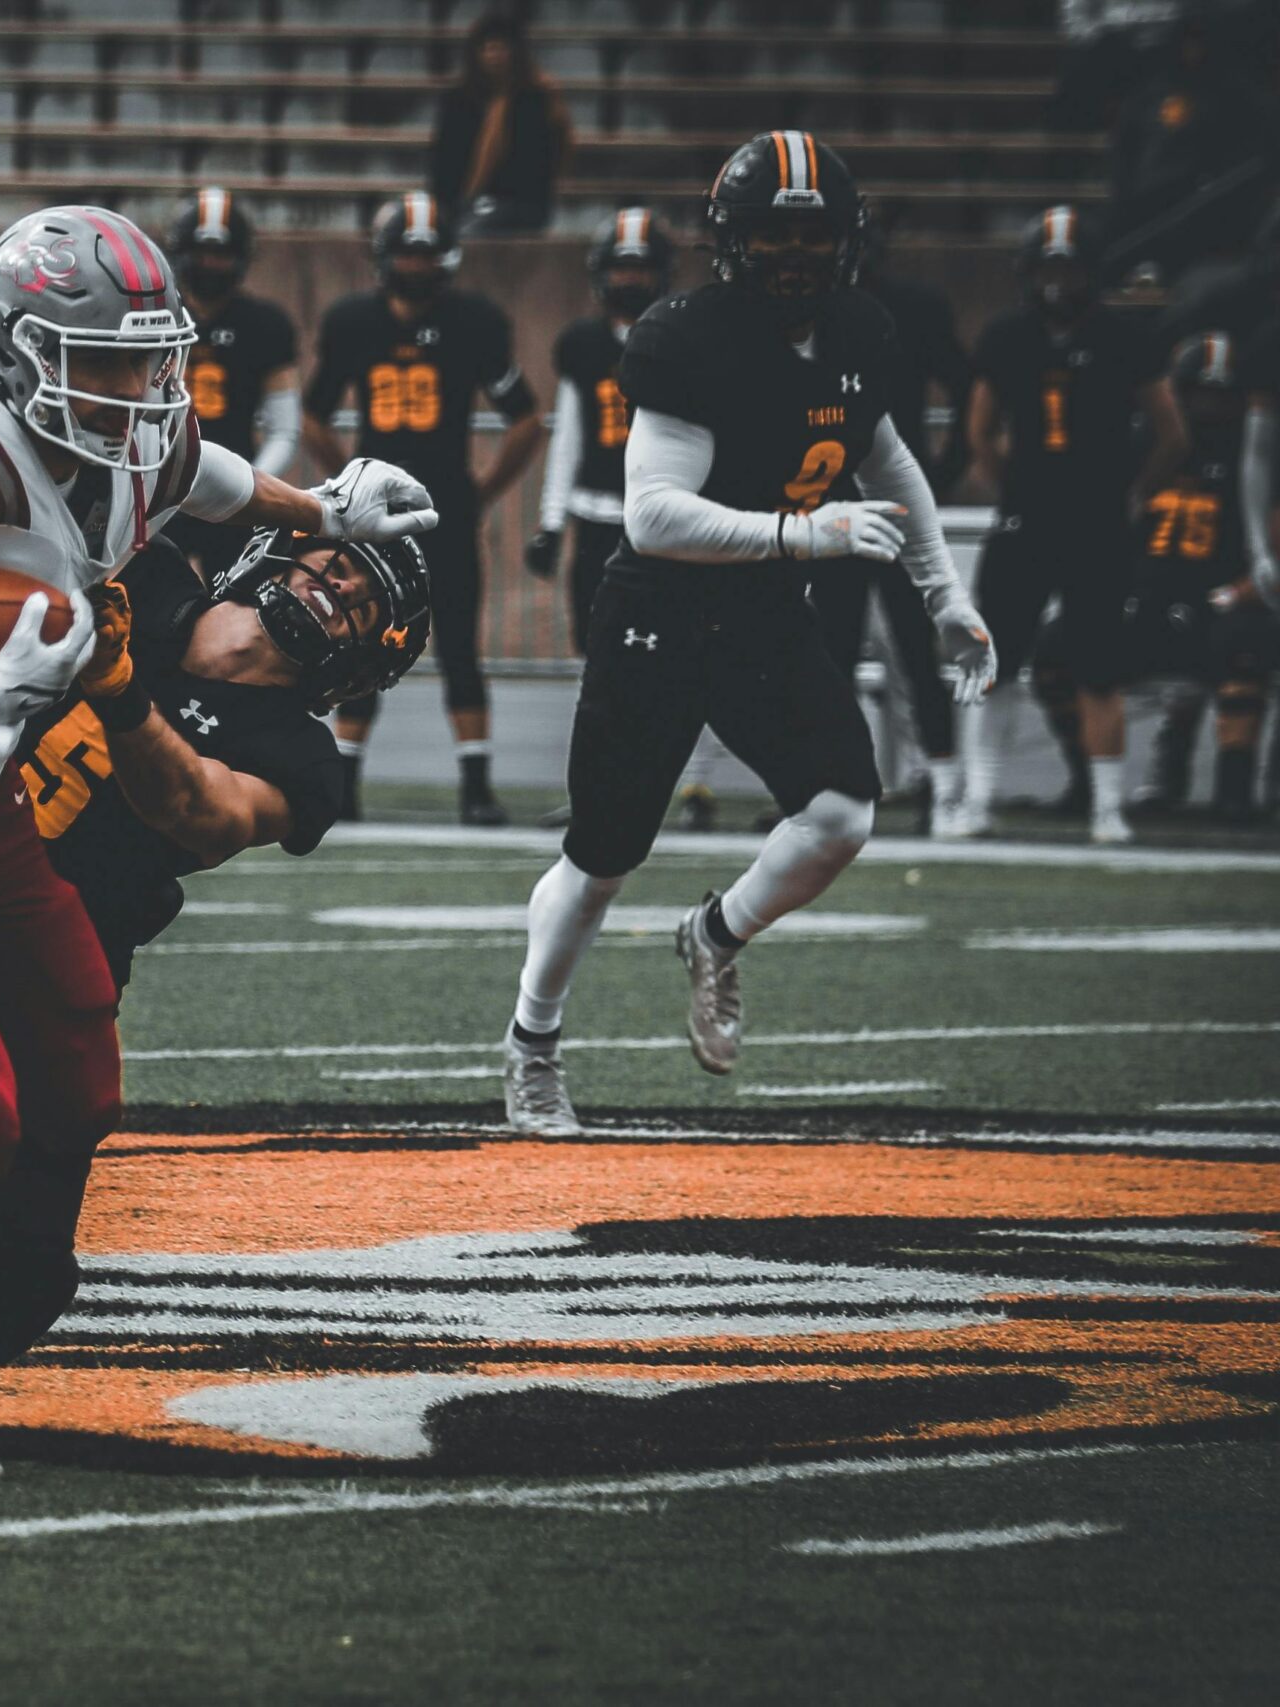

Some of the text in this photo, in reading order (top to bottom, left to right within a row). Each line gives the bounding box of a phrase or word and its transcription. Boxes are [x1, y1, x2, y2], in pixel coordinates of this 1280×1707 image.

[131, 318, 147, 327] WE
[184, 362, 227, 421] 6
[595, 378, 629, 447] 1
[1043, 388, 1068, 453] 1
[782, 439, 847, 516] 2
